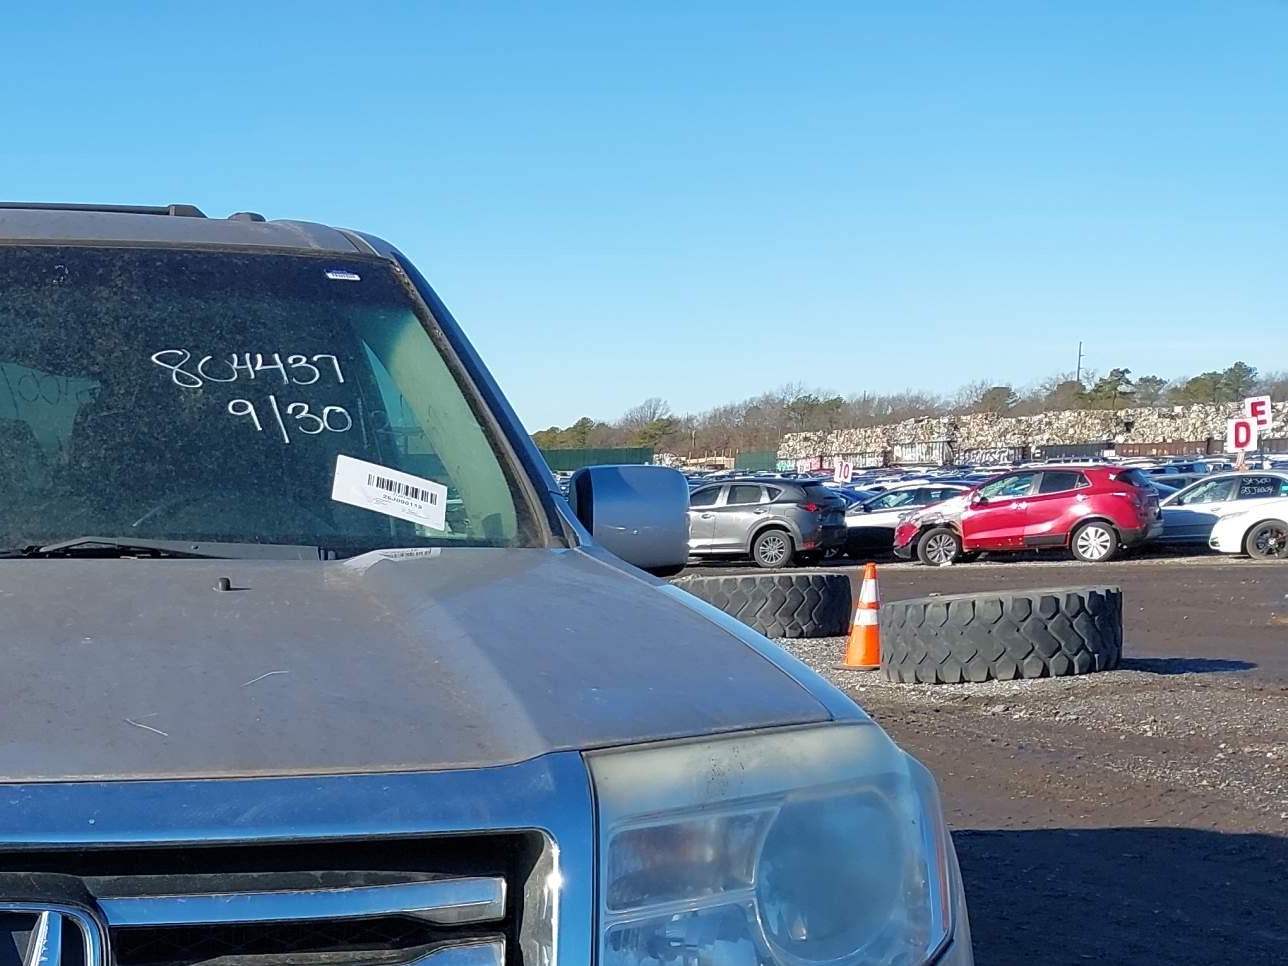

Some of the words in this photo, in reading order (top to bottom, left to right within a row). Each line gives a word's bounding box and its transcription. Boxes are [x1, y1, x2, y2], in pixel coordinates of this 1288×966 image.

[228, 395, 353, 444] 9/30
[1250, 401, 1268, 426] E
[1234, 421, 1252, 449] D
[839, 461, 850, 479] 10
